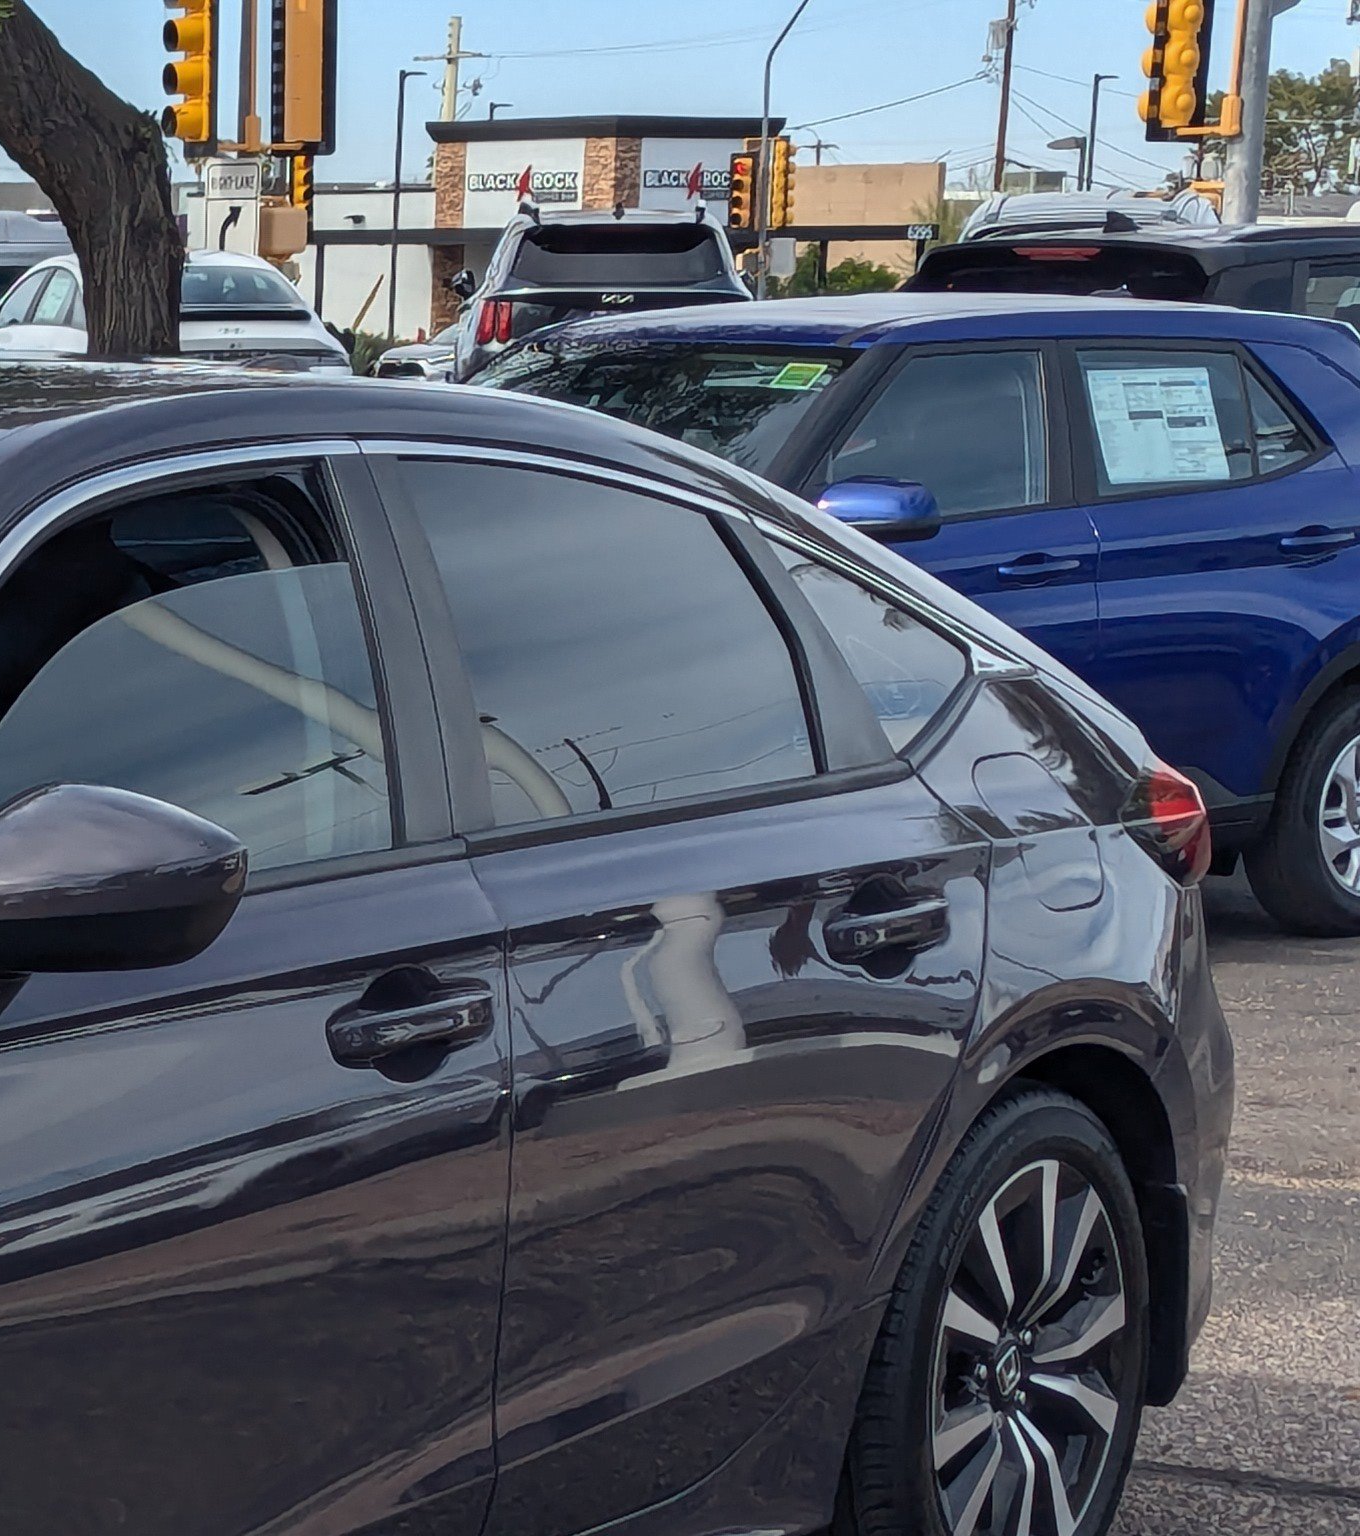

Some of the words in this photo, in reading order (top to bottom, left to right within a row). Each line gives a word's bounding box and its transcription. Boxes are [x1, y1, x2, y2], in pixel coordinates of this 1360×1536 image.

[468, 173, 518, 191] BLACK
[532, 172, 577, 189] ROCK
[644, 170, 689, 188] BLACK
[702, 170, 731, 187] ROC
